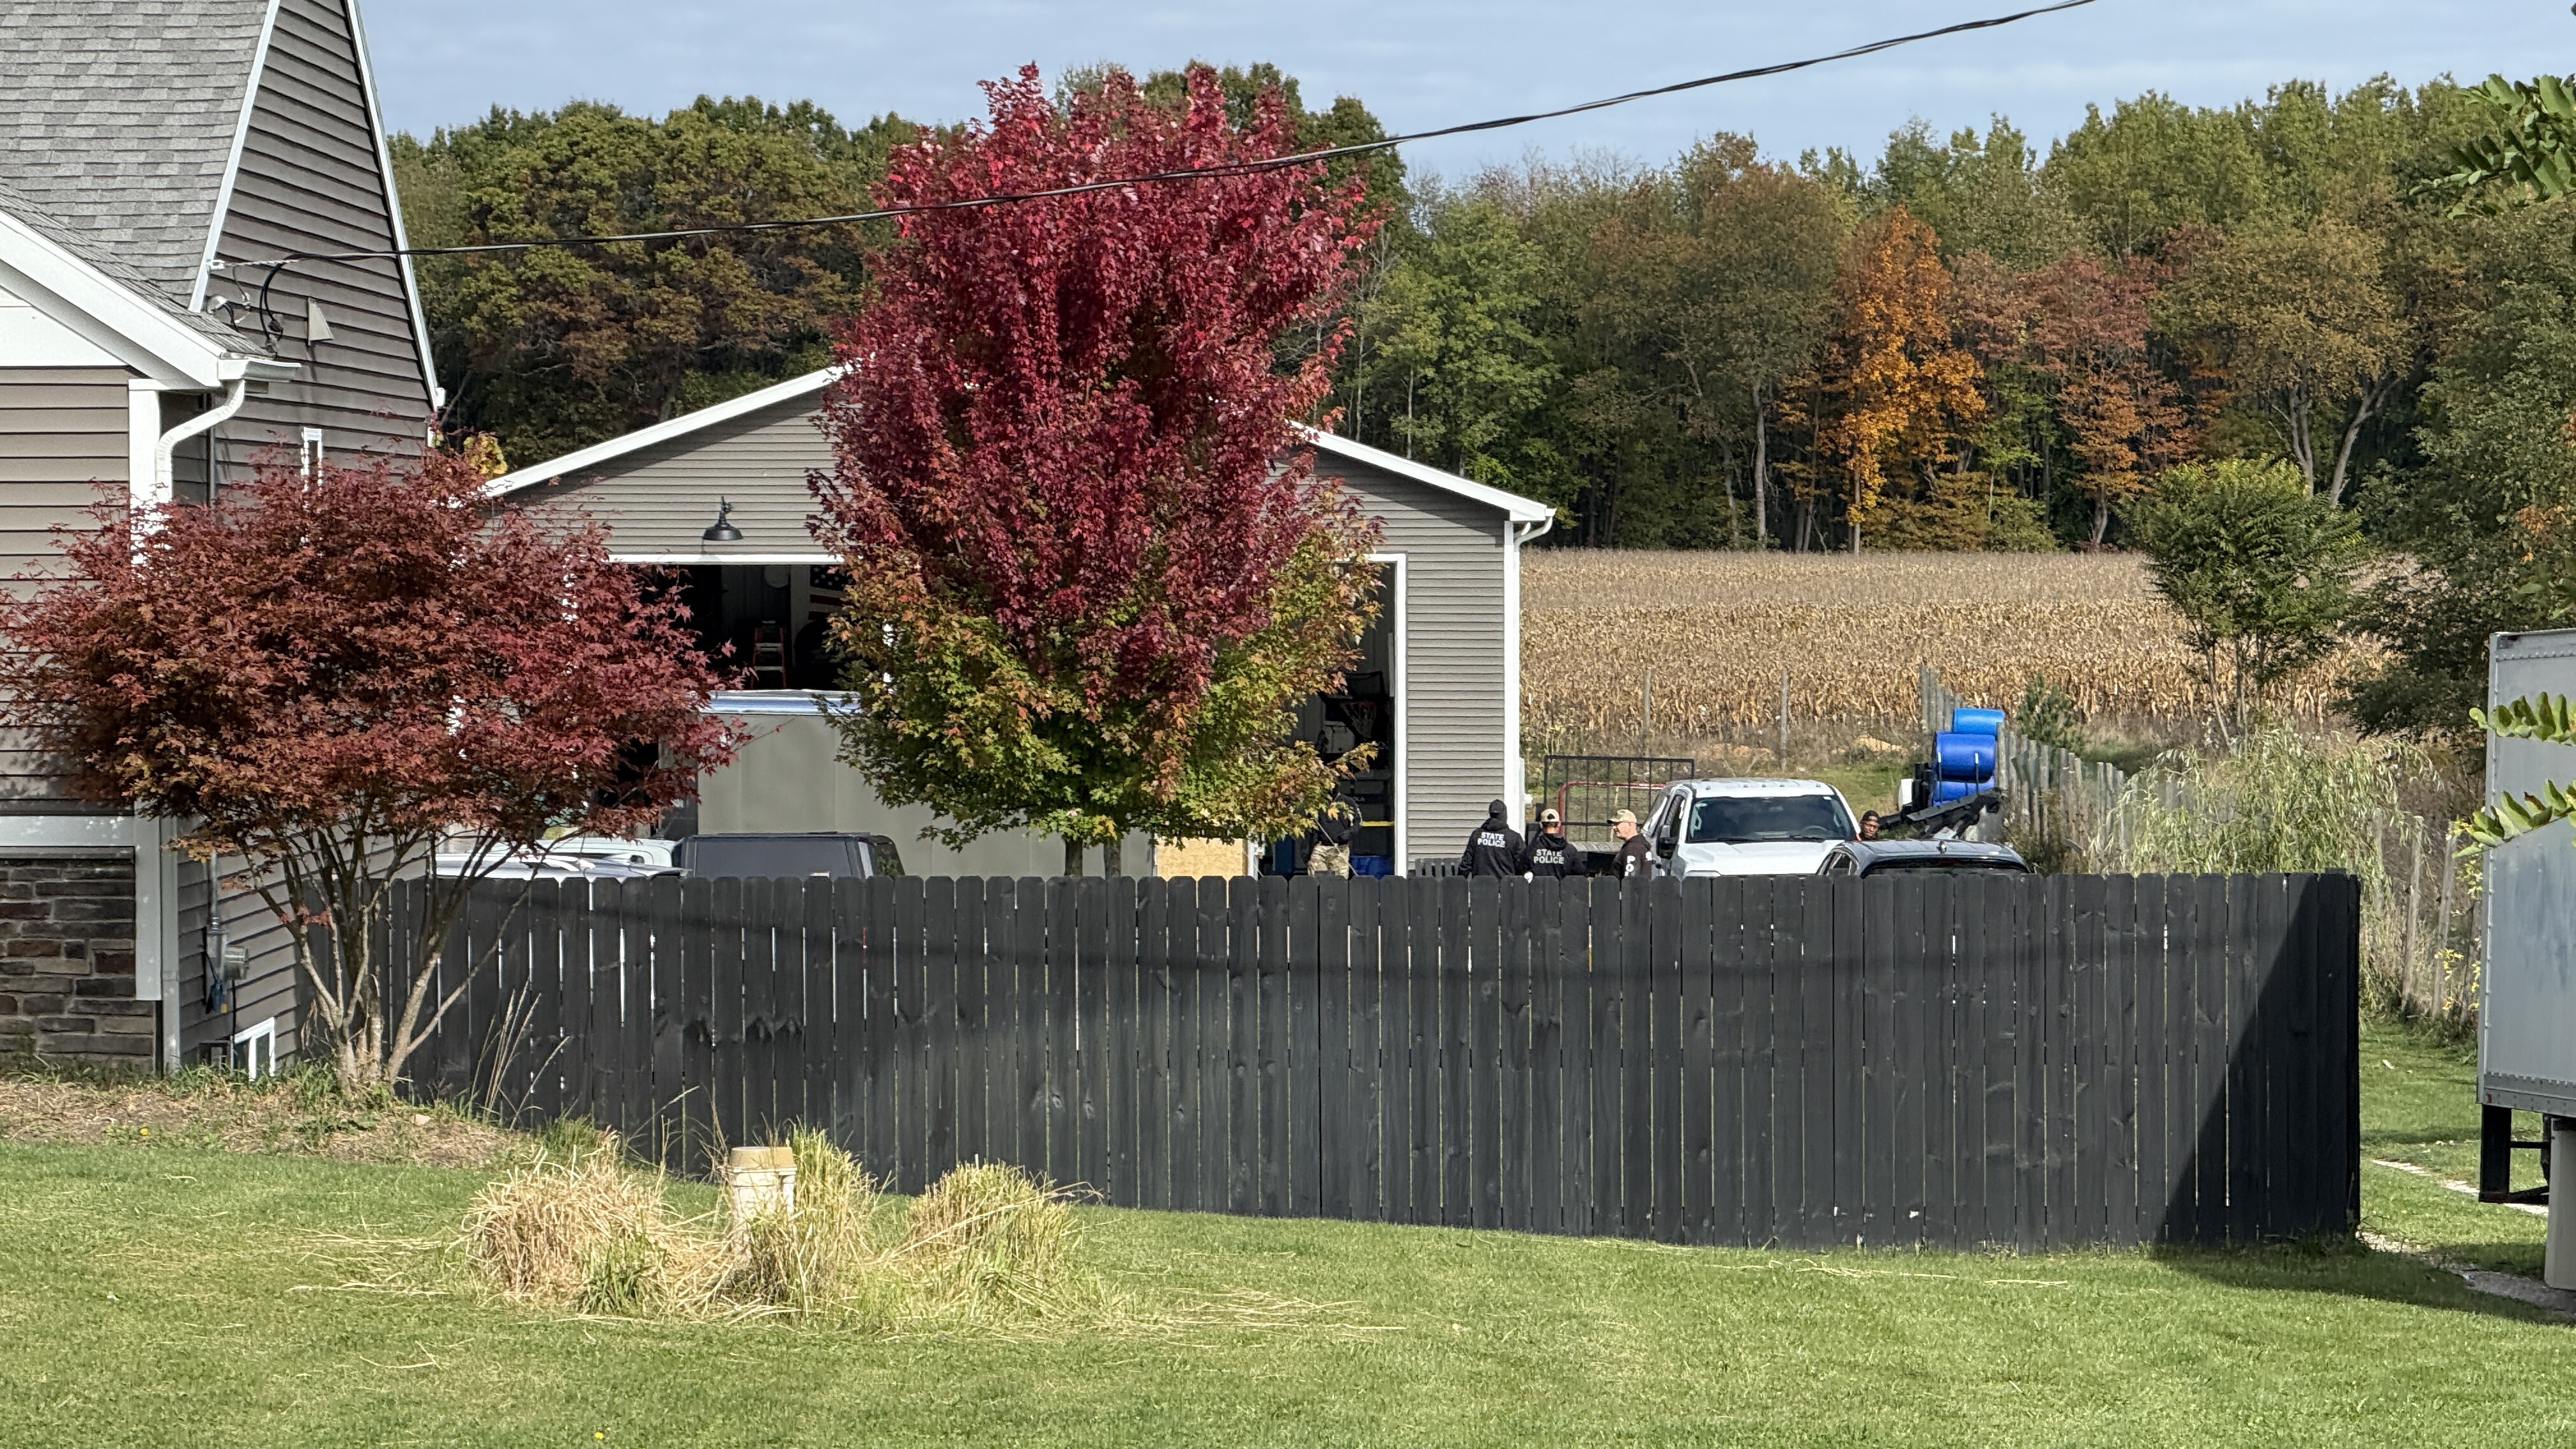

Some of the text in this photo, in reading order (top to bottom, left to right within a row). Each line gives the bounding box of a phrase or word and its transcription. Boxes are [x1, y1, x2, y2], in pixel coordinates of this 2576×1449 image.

[1481, 832, 1504, 841] STATE
[1477, 838, 1505, 848] POLICE
[1536, 848, 1563, 857] STATE
[1533, 856, 1565, 864] POLICE
